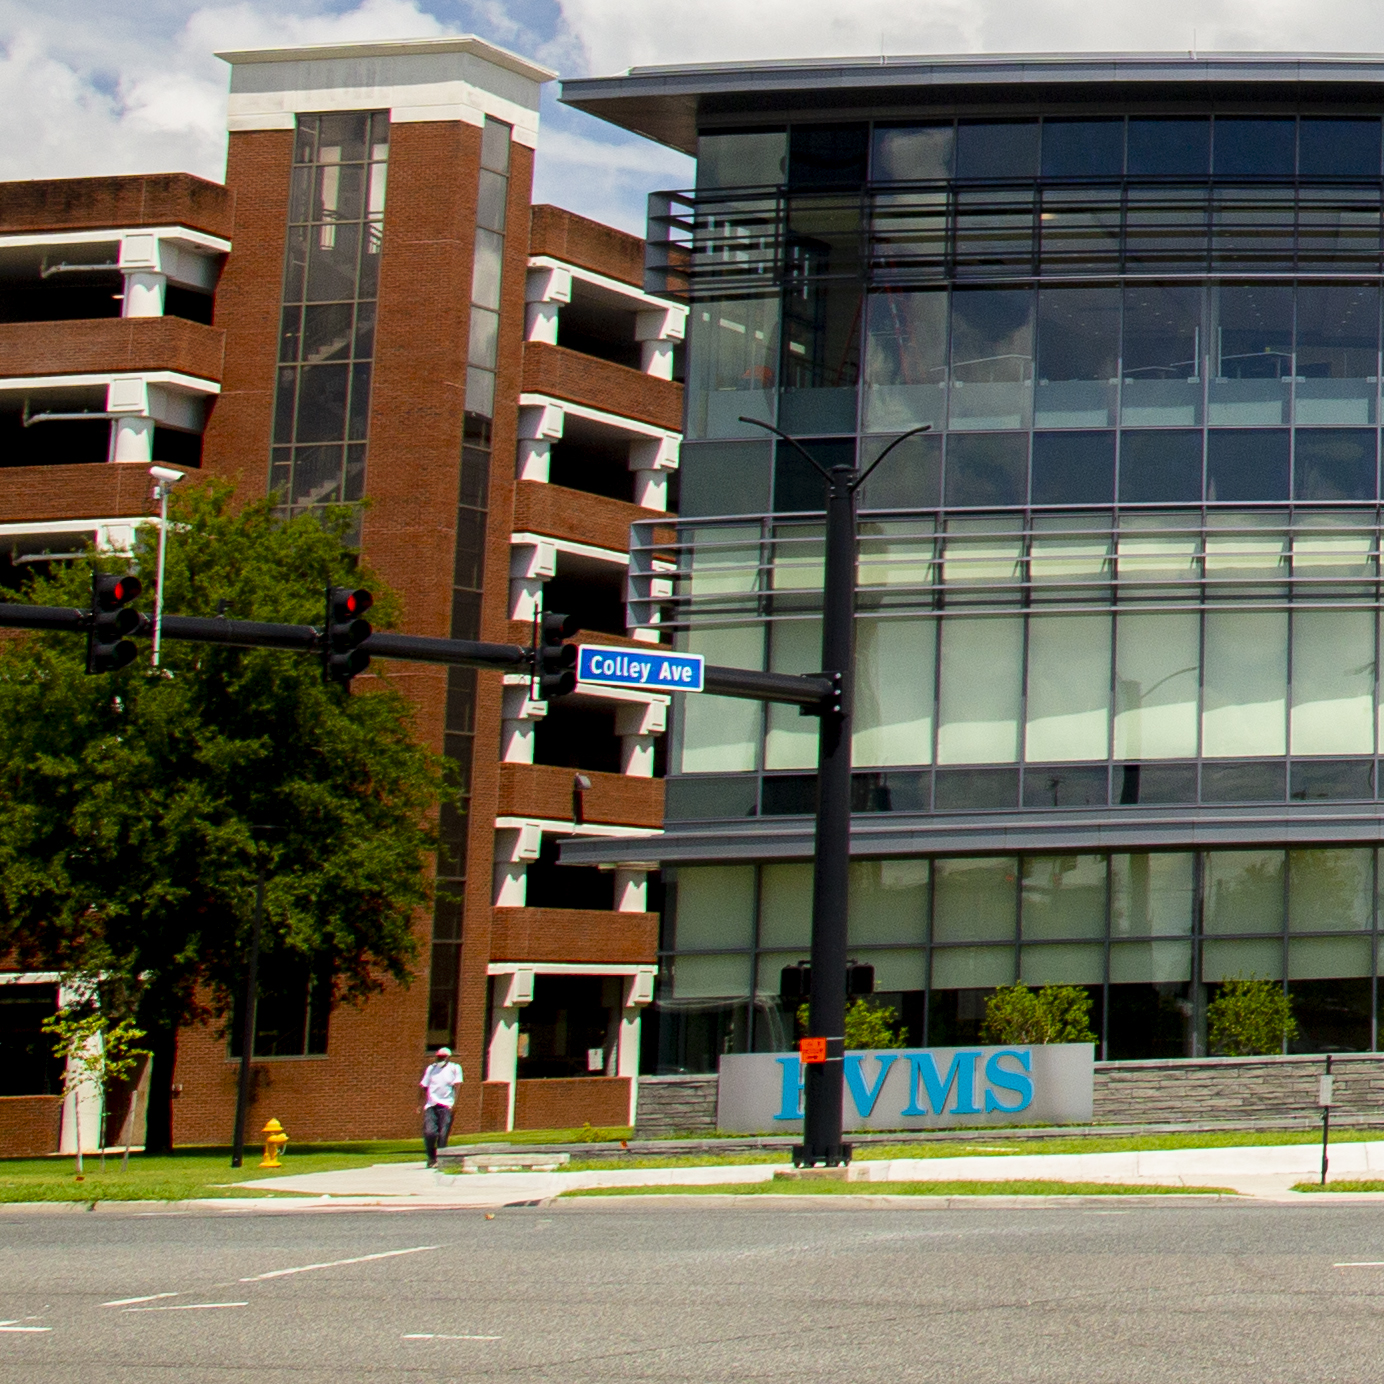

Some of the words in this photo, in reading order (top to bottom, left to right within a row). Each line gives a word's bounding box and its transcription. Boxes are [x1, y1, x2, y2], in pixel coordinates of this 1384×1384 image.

[590, 655, 651, 683] Colley
[658, 661, 693, 682] Ave
[773, 1049, 1035, 1121] EVMS
